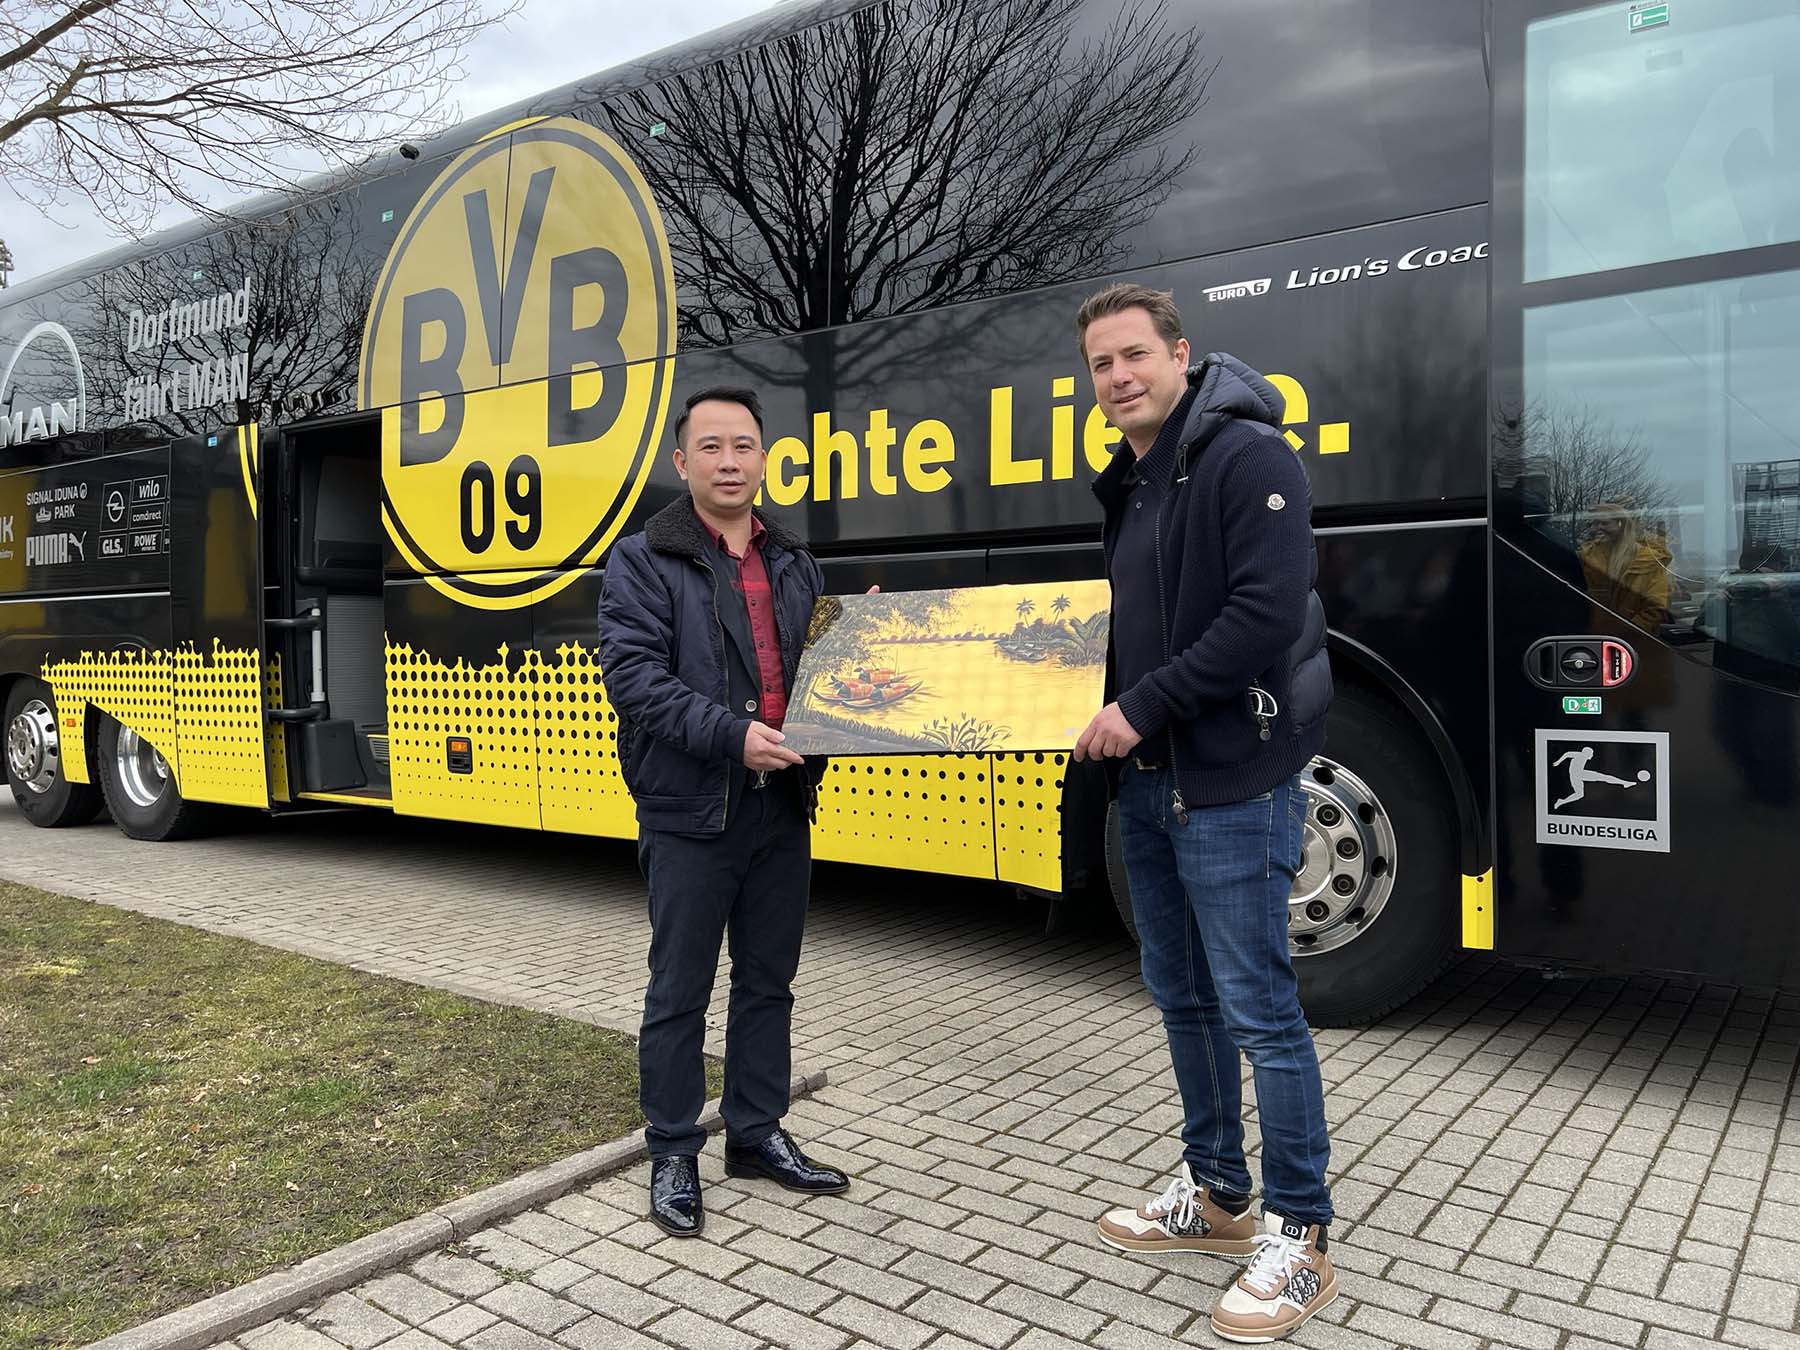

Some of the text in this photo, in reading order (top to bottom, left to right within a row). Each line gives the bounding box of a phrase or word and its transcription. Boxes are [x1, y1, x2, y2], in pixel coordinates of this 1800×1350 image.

[1286, 257, 1389, 290] Lion's
[1208, 286, 1247, 302] EURO
[127, 277, 251, 353] Dortmund
[399, 166, 628, 467] BVB
[124, 352, 249, 422] fährt MAN
[0, 397, 77, 449] MAN
[753, 373, 1350, 506] chte Liee.
[26, 485, 79, 506] SIGNAL IDUNA
[139, 479, 160, 499] wilo
[460, 454, 542, 554] 09
[54, 504, 76, 520] PARK
[132, 510, 162, 522] comdirect
[26, 533, 68, 566] PUMA
[134, 534, 158, 548] ROWE
[1547, 822, 1658, 841] BUNDESLIGA
